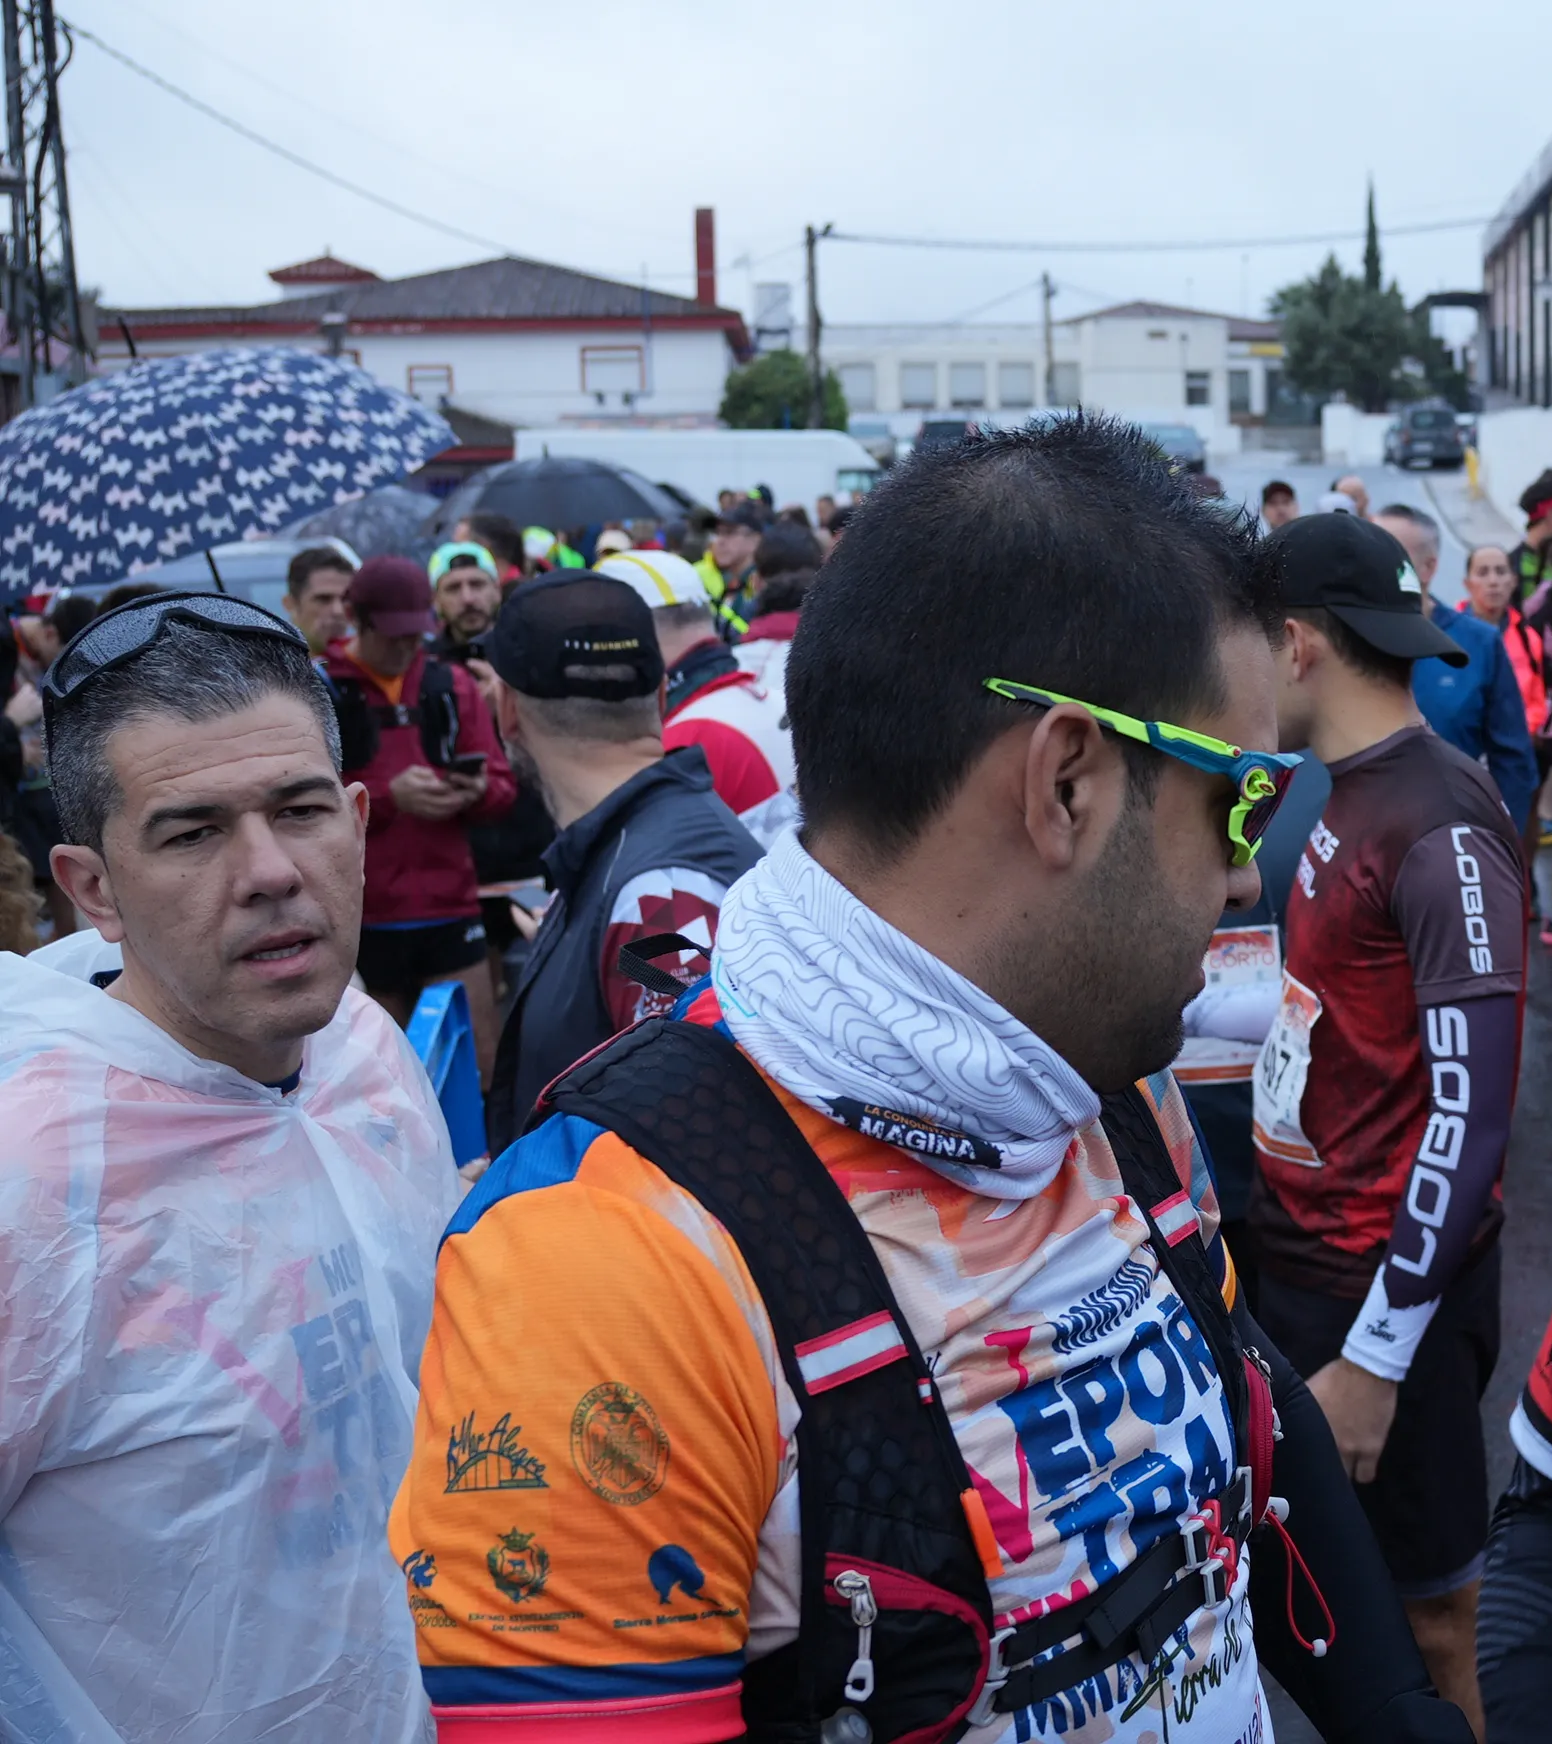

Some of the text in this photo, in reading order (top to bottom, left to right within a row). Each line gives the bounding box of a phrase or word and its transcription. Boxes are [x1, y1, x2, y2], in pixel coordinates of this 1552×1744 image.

[1209, 951, 1275, 969] CORTO
[1451, 826, 1493, 974] LOBOS
[863, 1104, 881, 1117] LA
[1391, 1006, 1470, 1277] LOBOS
[997, 1294, 1224, 1496] EPOR
